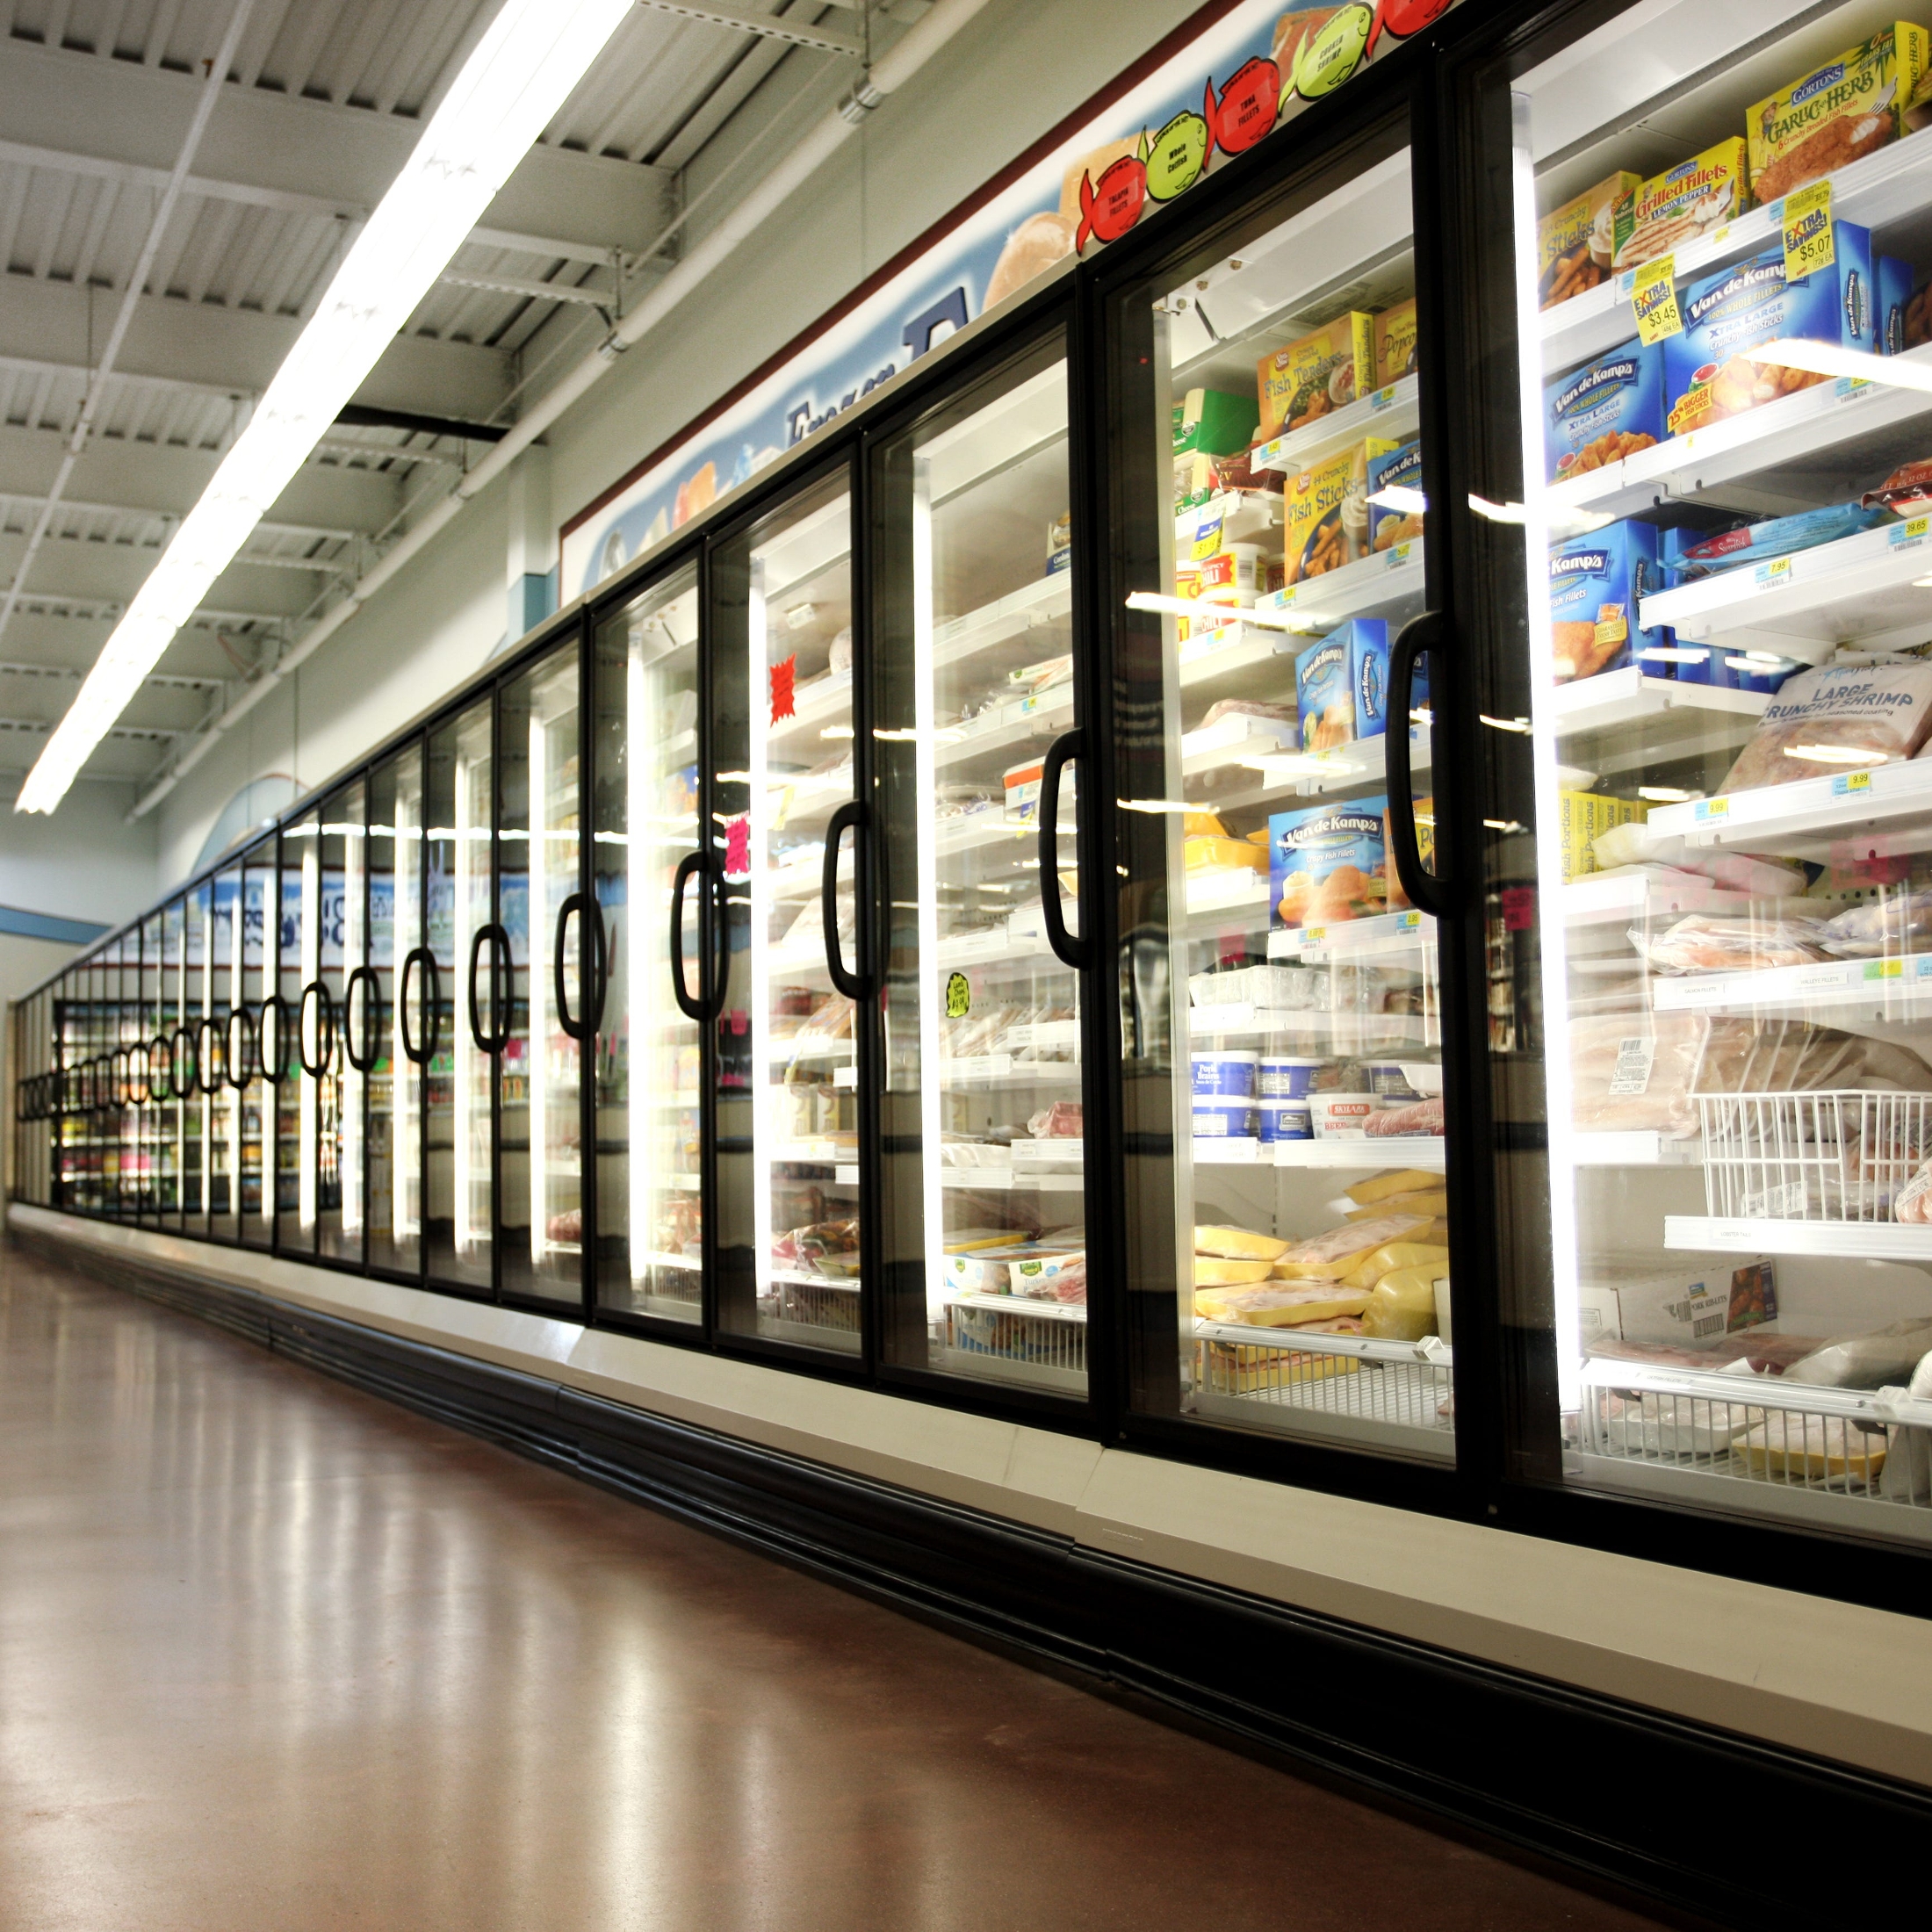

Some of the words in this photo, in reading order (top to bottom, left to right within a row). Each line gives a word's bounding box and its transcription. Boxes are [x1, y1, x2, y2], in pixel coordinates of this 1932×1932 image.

[1319, 35, 1344, 59] COOKED
[1882, 38, 1893, 53] FAT
[1317, 47, 1342, 71] SHRIMP
[1240, 94, 1256, 112] TUNA
[1767, 99, 1820, 144] GARLIC
[1827, 70, 1874, 112] HERB
[1238, 105, 1259, 127] FILLETS
[1777, 140, 1784, 150] 6
[1784, 126, 1806, 147] Crunchy
[1806, 116, 1828, 133] Breaded
[1828, 108, 1841, 120] Fish
[1841, 98, 1859, 115] Fillets
[1169, 143, 1186, 160] Whole
[1167, 155, 1187, 174] Catfish
[1635, 181, 1683, 219] Grilled
[1685, 163, 1727, 191] Fillets
[1653, 196, 1678, 219] LEMON
[1679, 184, 1710, 207] PEPPER
[1109, 199, 1128, 218] FILLETS
[1785, 208, 1823, 244] EXTRA
[1787, 213, 1827, 254] SAVINGS!
[1546, 219, 1595, 259] Sticks
[1799, 234, 1831, 262] $5.07
[1825, 252, 1833, 262] EA
[1634, 280, 1666, 311] EXTRA
[1690, 290, 1722, 319] Van
[1723, 279, 1743, 296] de
[1743, 263, 1787, 287] Kamp
[1708, 307, 1726, 321] 100%
[1726, 295, 1754, 314] WHOLE
[1754, 283, 1783, 304] FILLETS
[1637, 285, 1671, 321] SAVINGS!
[1648, 304, 1676, 328] $3.45
[1709, 320, 1741, 339] XTRA
[1744, 301, 1784, 326] LARGE
[1709, 332, 1741, 353] Crunchy
[1759, 313, 1783, 332] Sticks
[1377, 332, 1417, 364] Popco
[1263, 373, 1292, 400] Fish
[1293, 350, 1345, 386] Tenders
[1555, 387, 1579, 413] Van
[1579, 378, 1592, 393] de
[1592, 363, 1633, 386] Kamp's
[1581, 393, 1600, 409] WHOLE
[1600, 383, 1620, 400] FILLETS
[1683, 388, 1709, 411] BIGGER
[1568, 415, 1590, 431] XTRA
[1592, 399, 1621, 418] LARGE
[1685, 407, 1695, 416] FISH
[1695, 400, 1709, 412] STICKS
[1568, 426, 1590, 442] Crunchy
[1591, 418, 1603, 429] Fish
[1603, 409, 1620, 423] Sticks
[1321, 461, 1350, 483] Crunchy
[1378, 465, 1399, 485] Van
[1400, 457, 1412, 469] de
[1288, 497, 1312, 526] Fish
[1316, 477, 1359, 511] Sticks
[1906, 520, 1926, 533] 39.65
[1551, 554, 1604, 575] Kamp's
[1771, 560, 1786, 573] 7.95
[1201, 569, 1220, 587] HILI
[1558, 577, 1576, 588] FILLETS
[1565, 588, 1587, 603] Fillets
[1301, 663, 1313, 685] Van
[1313, 654, 1321, 672] de
[1321, 648, 1343, 665] Kamp's
[1362, 686, 1369, 696] de
[1812, 683, 1874, 702] LARGE
[1838, 692, 1914, 708] SHRIMP
[1364, 696, 1373, 716] Van
[1864, 708, 1894, 717] coating
[1853, 774, 1868, 783] 9.99
[1709, 804, 1724, 813] 9.99
[1287, 825, 1314, 843] Van
[1314, 819, 1330, 832] de
[1330, 817, 1379, 833] Kamp's
[1561, 797, 1571, 849] Portions
[1584, 801, 1595, 853] Portions
[1306, 852, 1324, 863] Crispy
[1324, 850, 1337, 861] Fish
[1337, 848, 1356, 858] Fillets
[1561, 855, 1571, 878] Fish
[1408, 914, 1418, 923] 2.95
[1800, 977, 1820, 985] WALLEYE
[1197, 1071, 1219, 1080] Brains
[1199, 1063, 1217, 1073] Pork
[1334, 1104, 1366, 1114] SKYLARK
